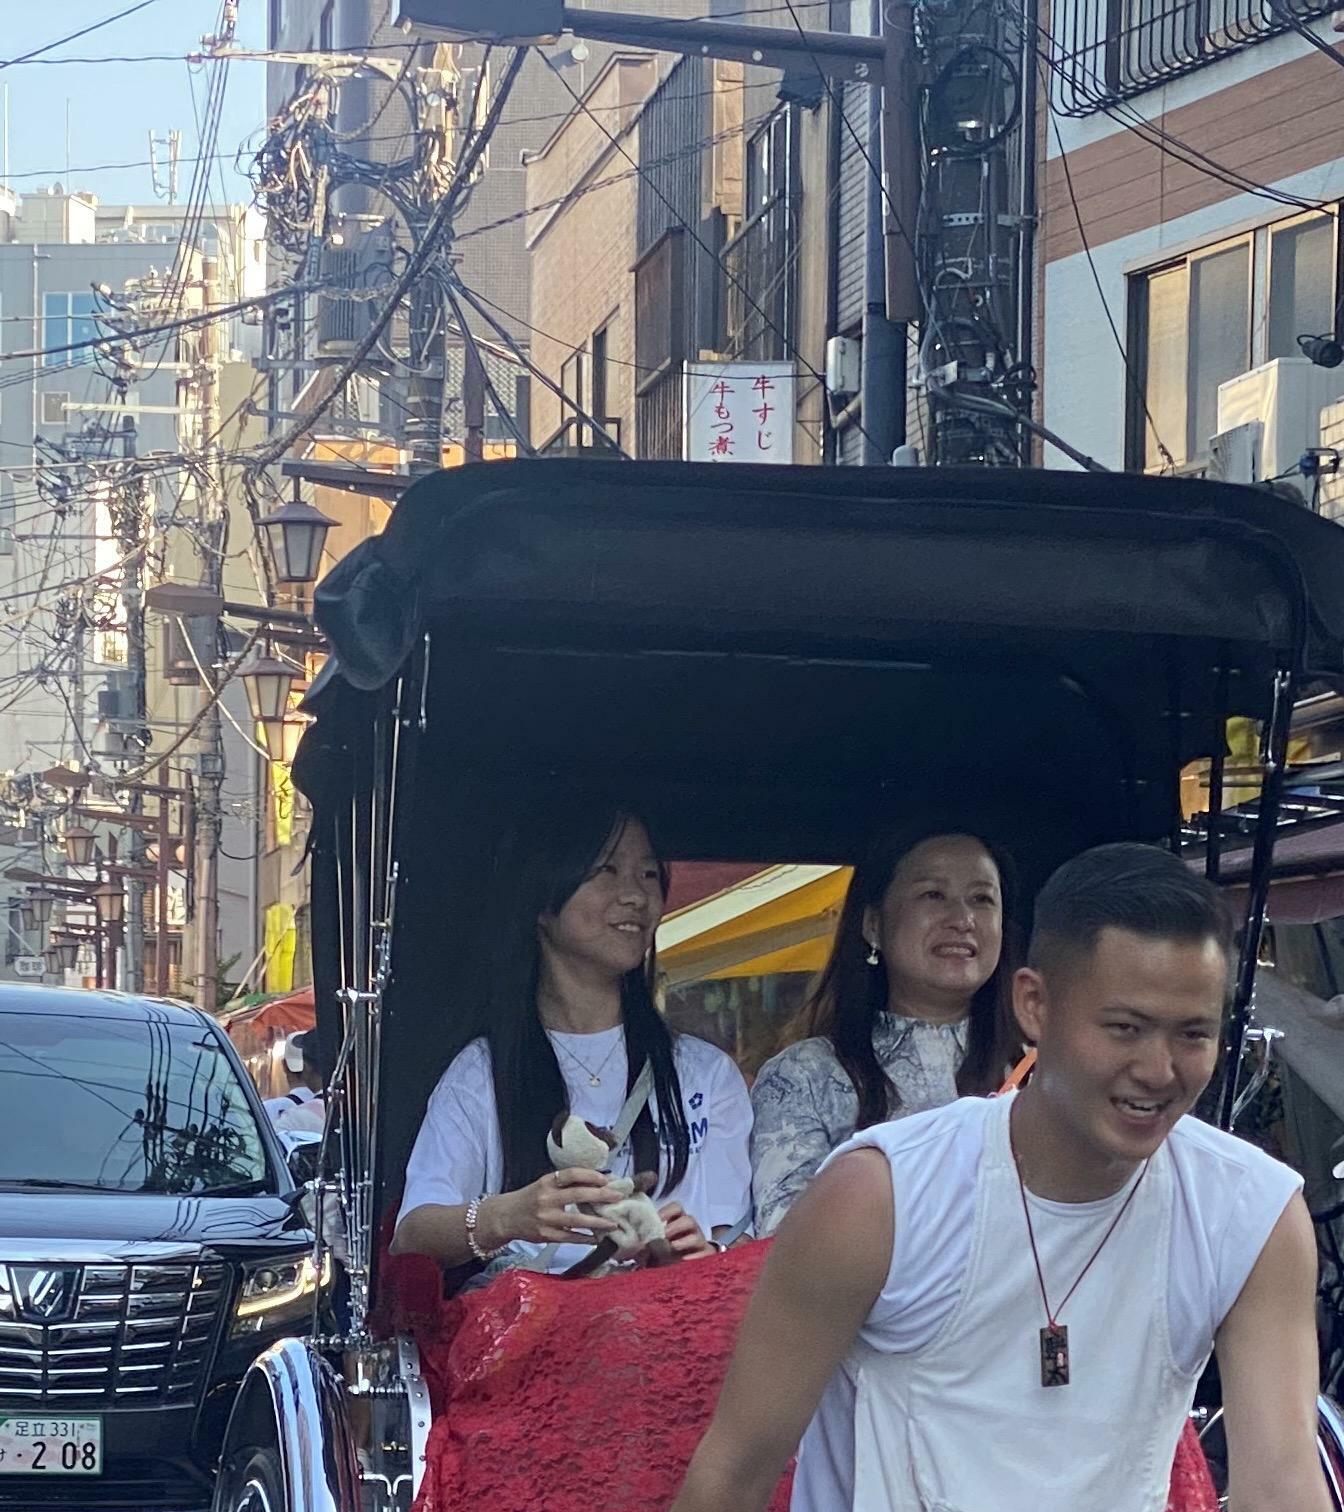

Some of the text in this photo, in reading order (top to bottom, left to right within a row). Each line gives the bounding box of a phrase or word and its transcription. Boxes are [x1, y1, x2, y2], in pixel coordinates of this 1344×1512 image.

[708, 381, 735, 462] 牛もつ煮
[751, 374, 775, 450] 牛すじ
[15, 1421, 76, 1437] 足立 331
